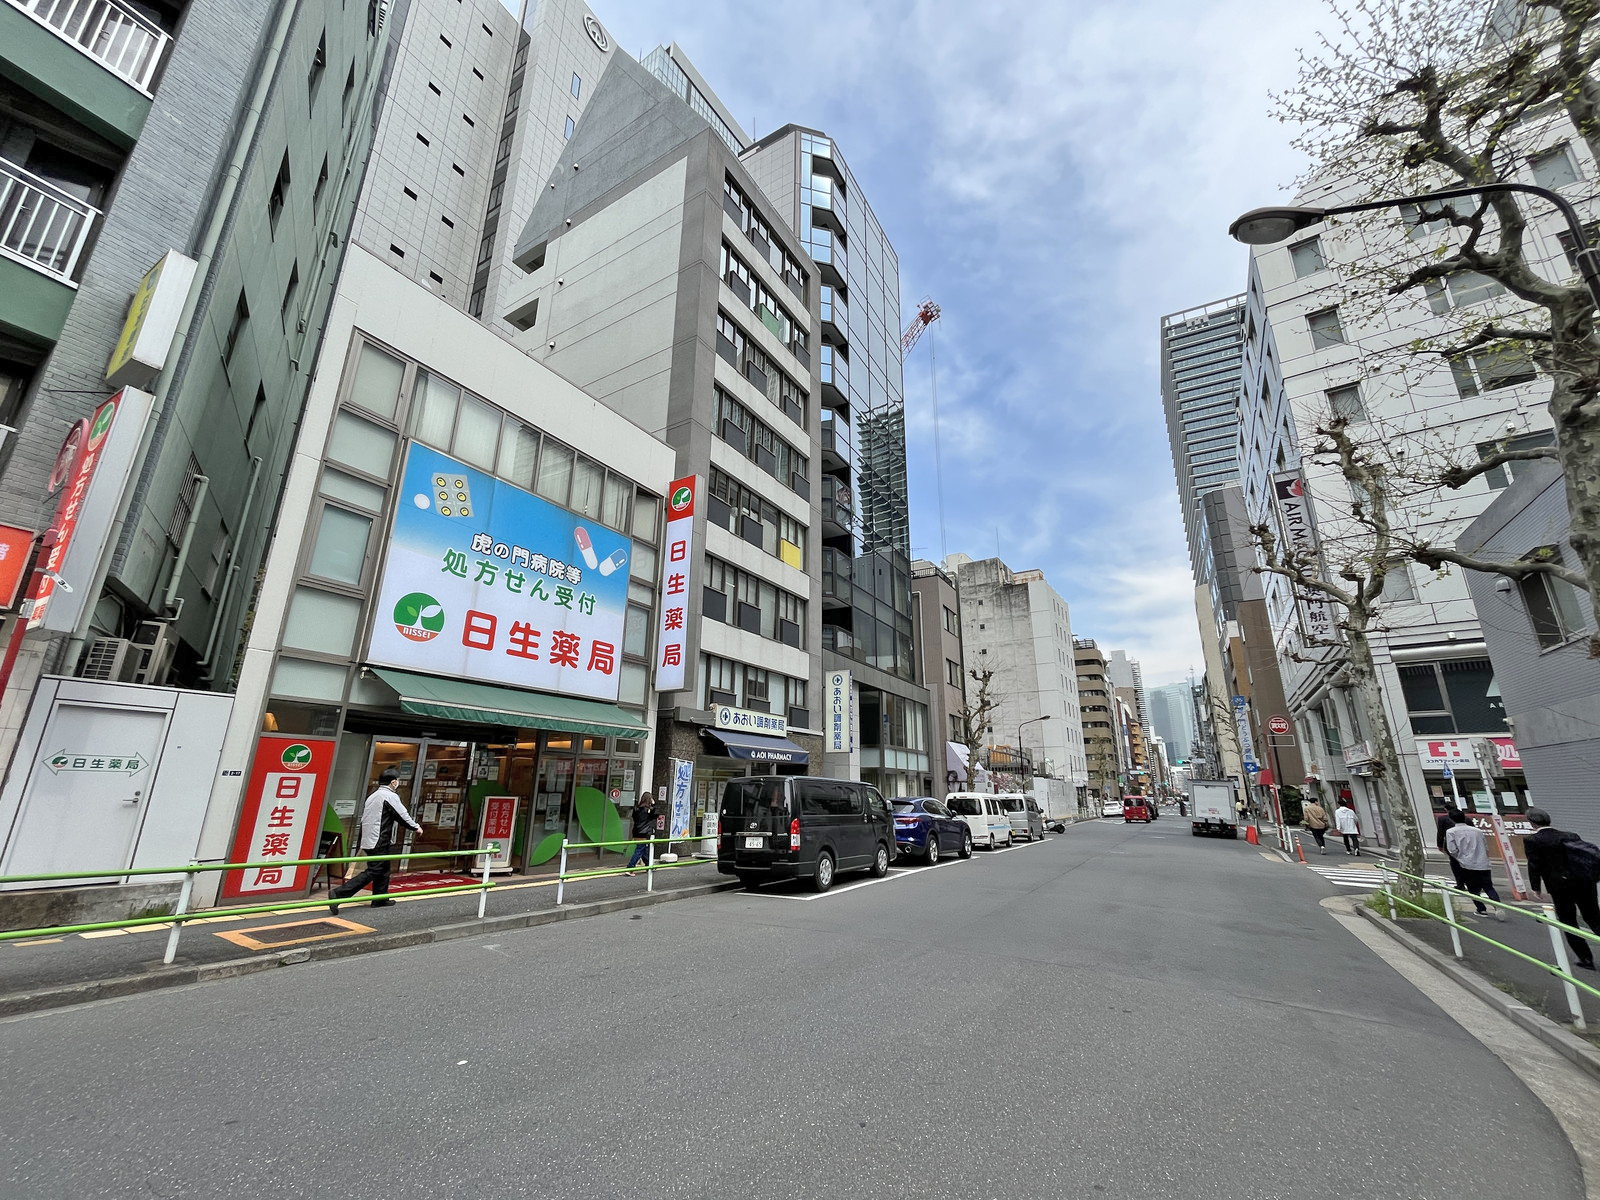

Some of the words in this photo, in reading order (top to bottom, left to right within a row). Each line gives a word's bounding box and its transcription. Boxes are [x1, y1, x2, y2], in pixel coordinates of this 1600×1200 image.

[1284, 502, 1303, 527] AIR
[441, 547, 597, 617] 処方せん受付
[470, 532, 583, 585] 虎の門病院等
[662, 539, 687, 668] 日生薬局
[461, 608, 616, 676] 日生薬局
[732, 711, 785, 732] あおい調剤薬局
[832, 687, 842, 750] あおい調剤薬局
[72, 757, 140, 770] 日生薬局
[756, 751, 767, 759] AOI
[768, 752, 792, 761] PHARMACY
[253, 776, 302, 886] 日生薬局
[672, 765, 689, 835] 処方せん
